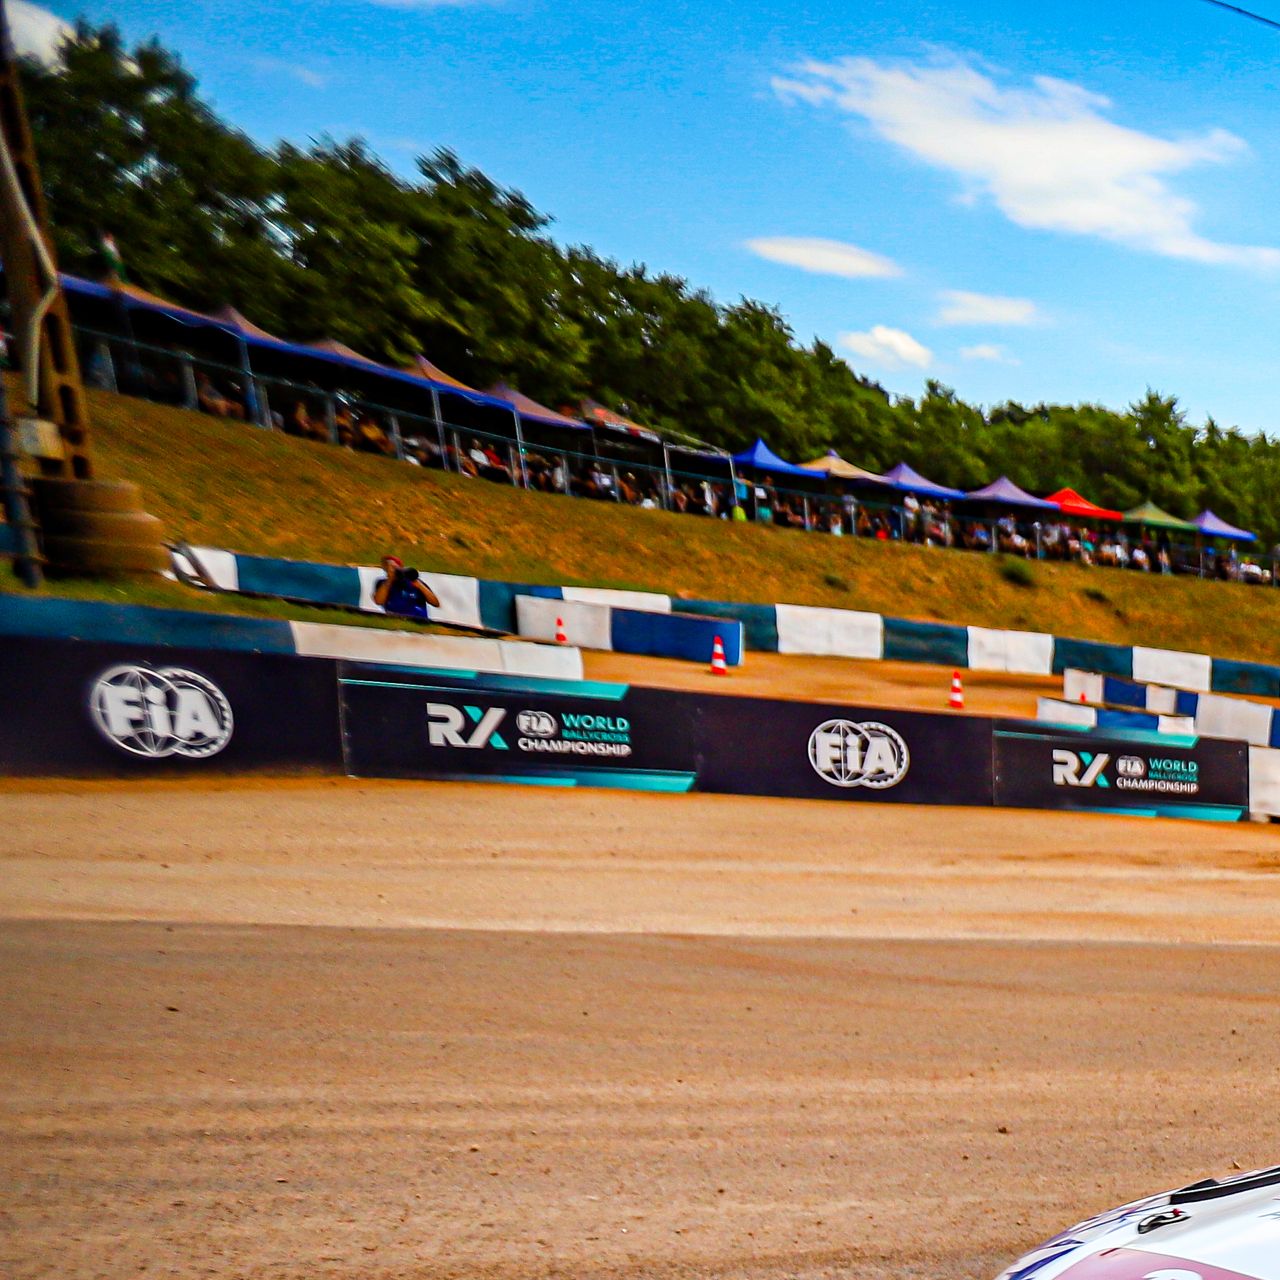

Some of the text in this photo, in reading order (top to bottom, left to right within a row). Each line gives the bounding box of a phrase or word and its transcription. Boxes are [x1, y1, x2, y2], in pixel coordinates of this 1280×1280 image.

[426, 702, 510, 750] RX
[561, 712, 630, 732] WORLD
[517, 736, 633, 758] CHAMPIONSHIP
[1052, 748, 1111, 788] RX
[1149, 757, 1198, 773] WORLD
[1116, 776, 1200, 795] CHAMPIONSHIP
